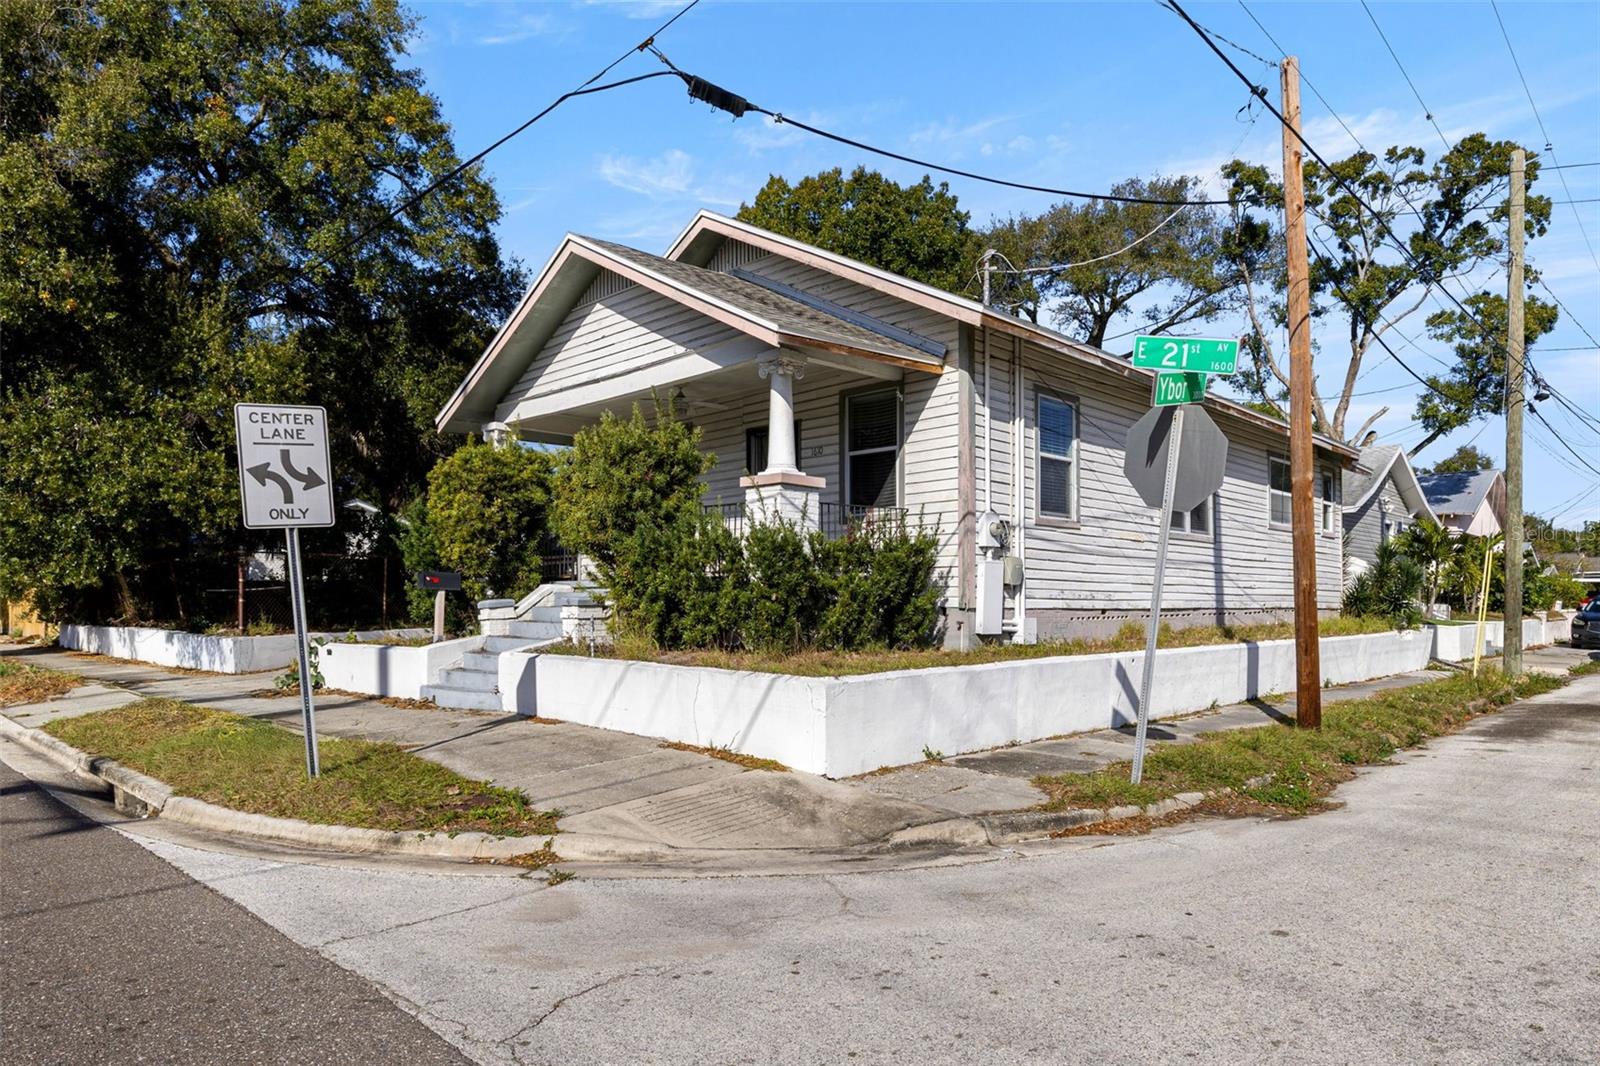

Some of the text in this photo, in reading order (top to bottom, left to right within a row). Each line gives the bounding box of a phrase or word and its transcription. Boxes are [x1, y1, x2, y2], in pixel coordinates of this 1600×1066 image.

[1138, 342, 1147, 358] E
[1217, 343, 1229, 352] AV
[1211, 361, 1233, 371] 1600
[1160, 377, 1187, 400] Ybor
[249, 412, 314, 425] CENTER
[260, 428, 306, 440] LANE
[269, 508, 309, 520] ONLY
